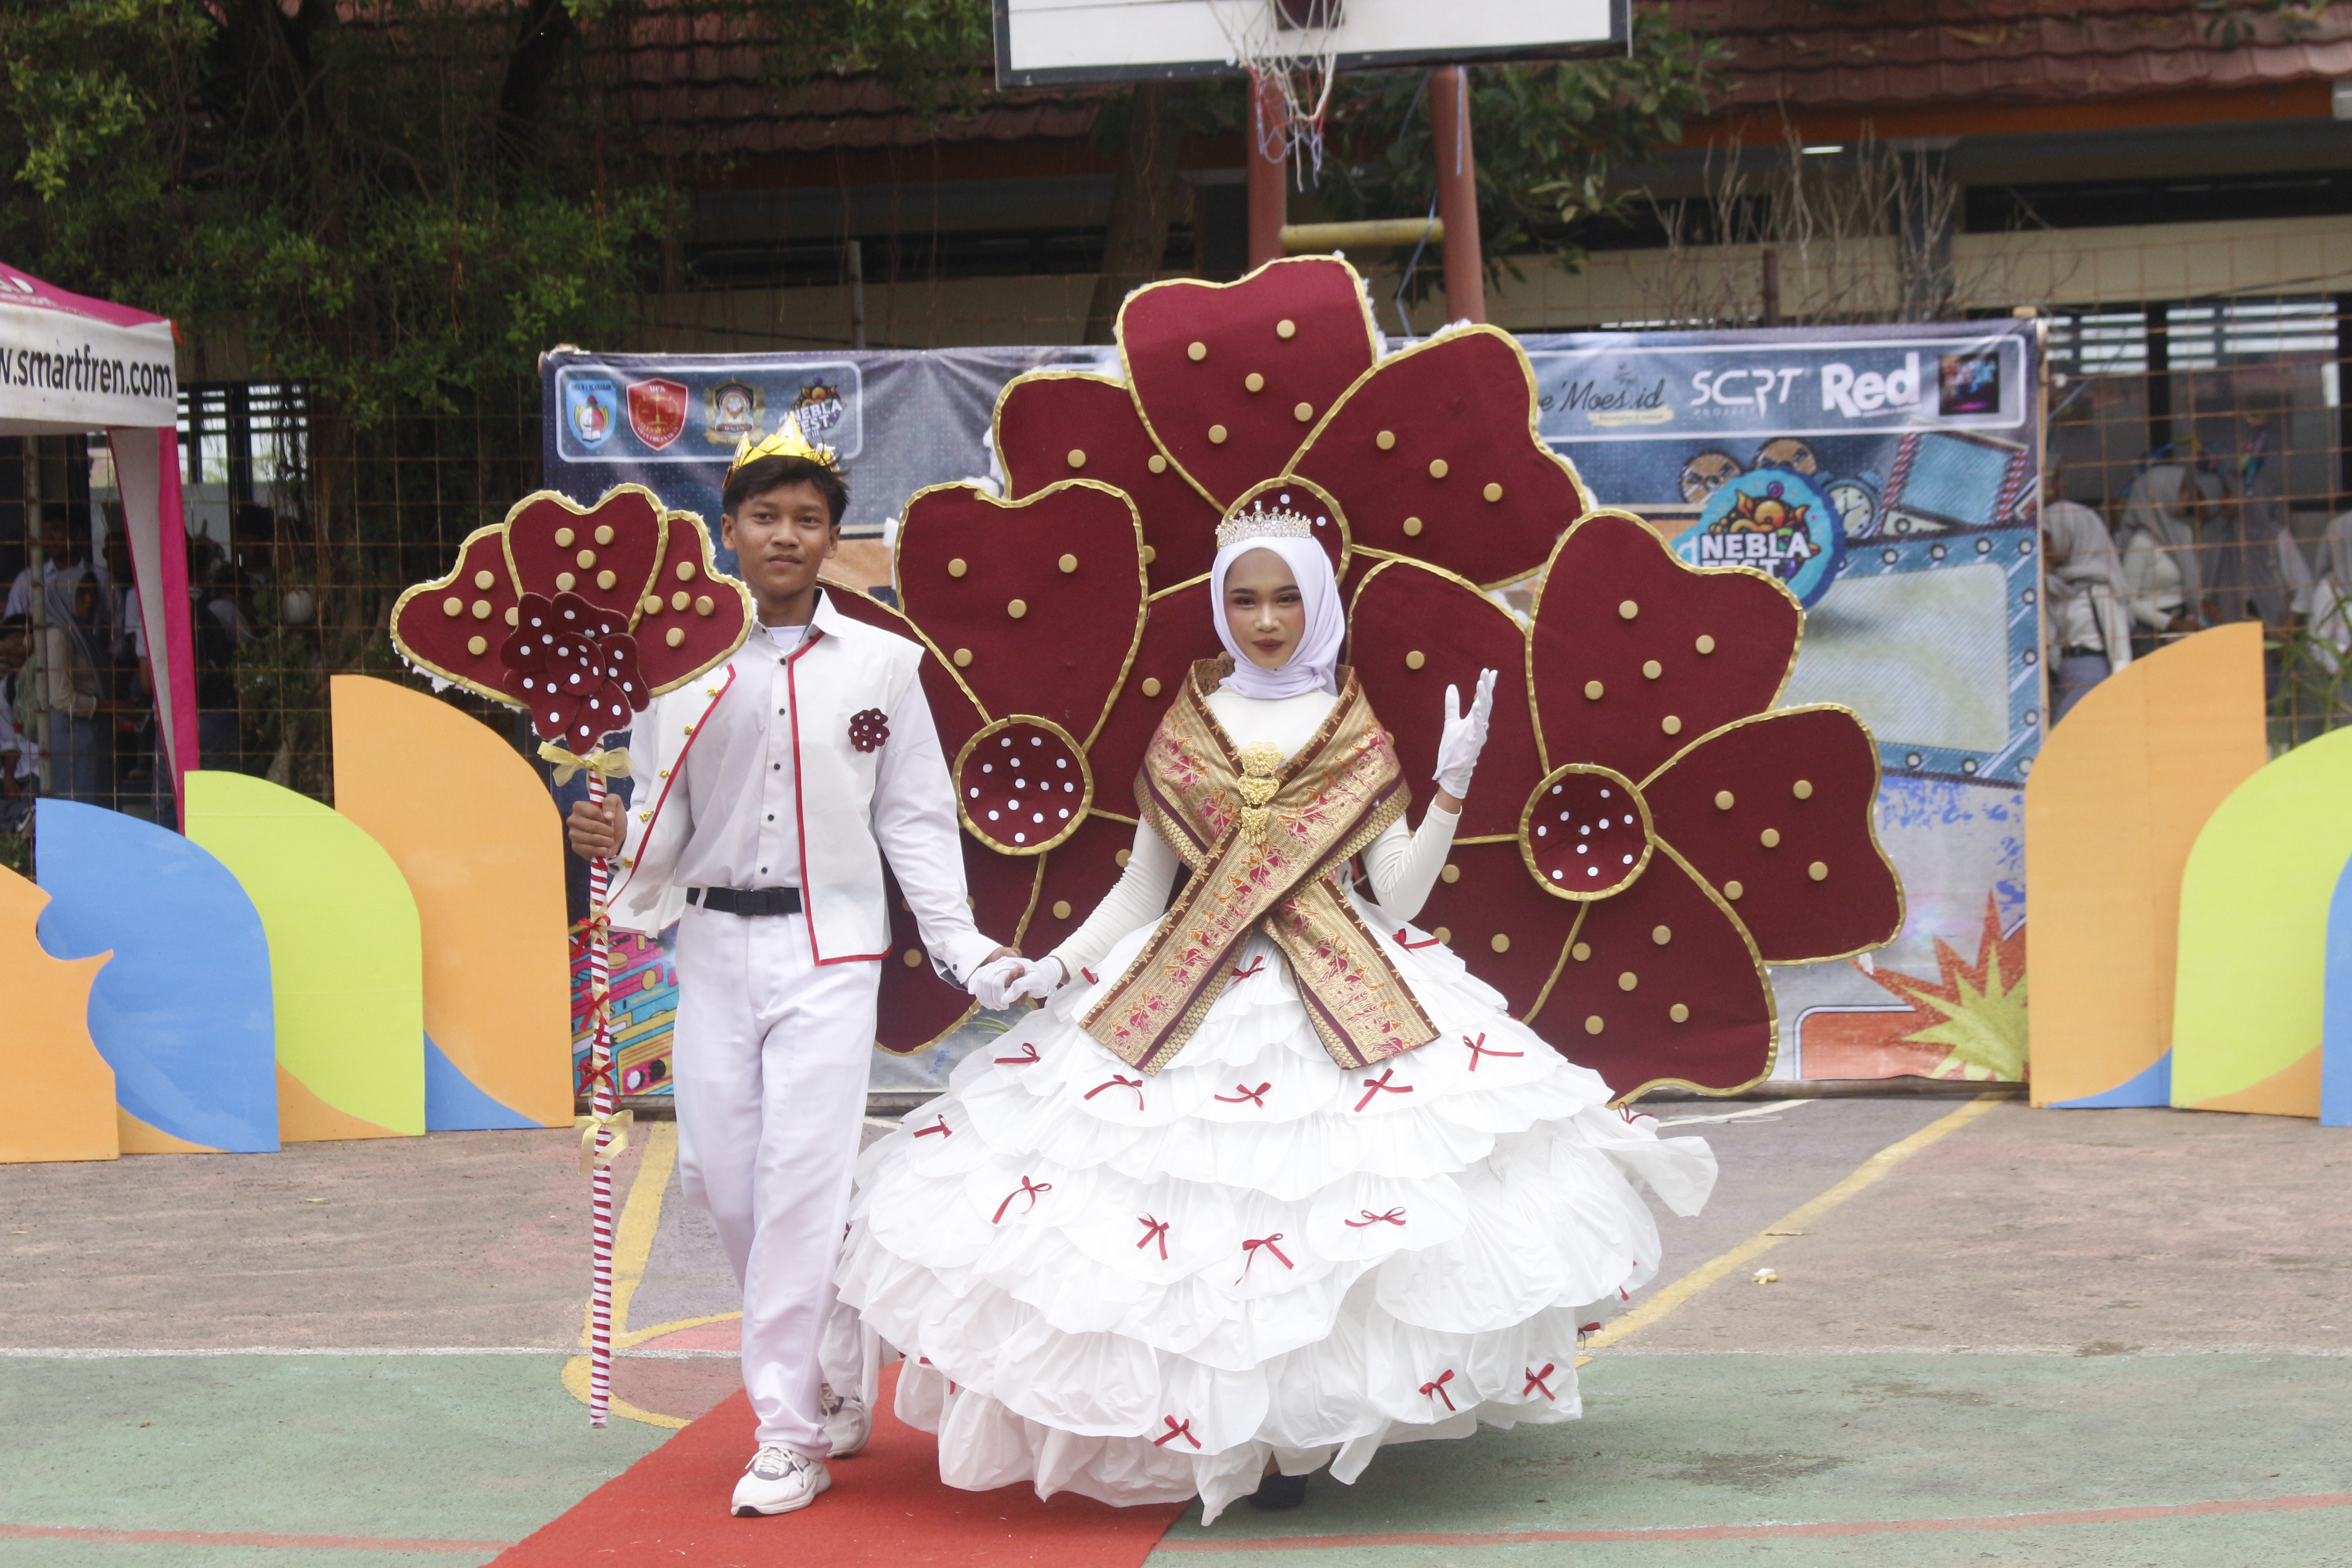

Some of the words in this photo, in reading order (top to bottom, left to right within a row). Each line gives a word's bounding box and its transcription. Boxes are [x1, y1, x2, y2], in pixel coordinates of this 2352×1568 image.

[1821, 352, 1920, 418] Red
[797, 414, 829, 433] EST
[1701, 531, 1812, 559] NEBLA
